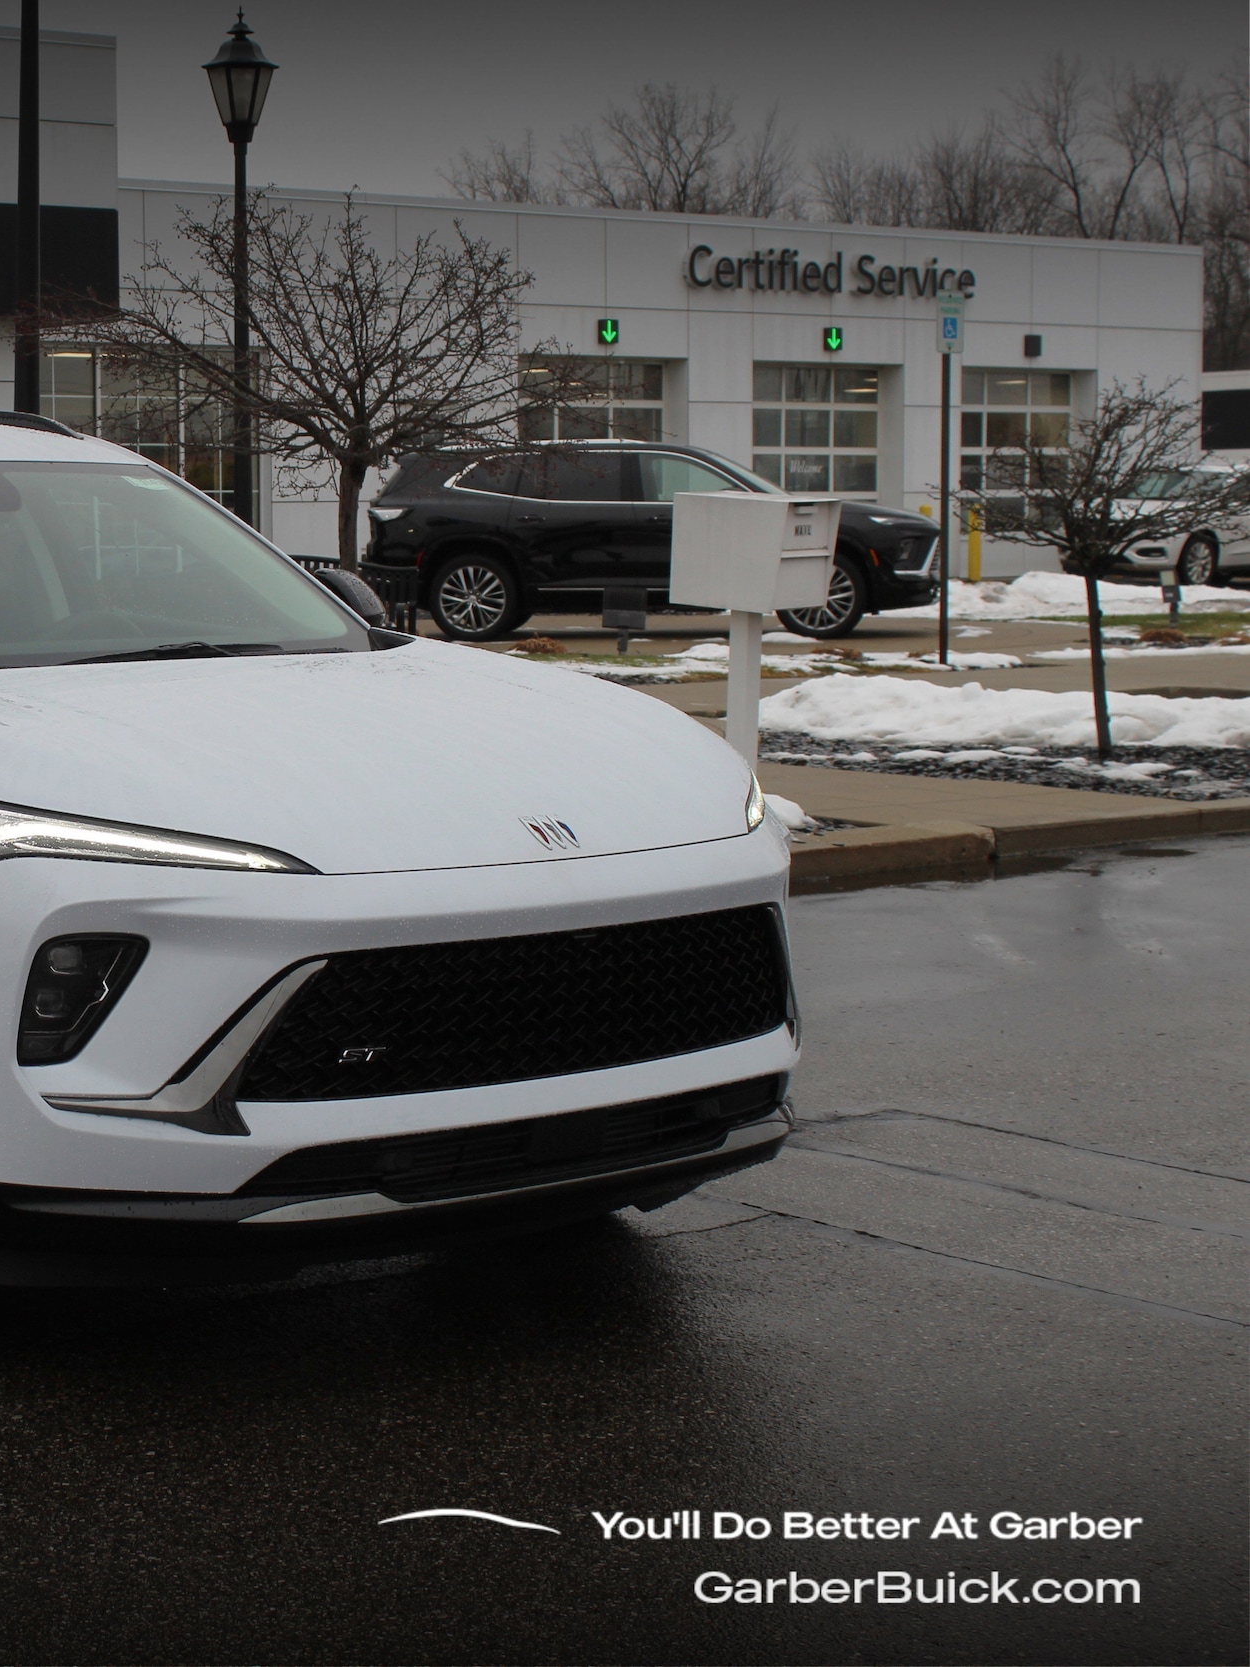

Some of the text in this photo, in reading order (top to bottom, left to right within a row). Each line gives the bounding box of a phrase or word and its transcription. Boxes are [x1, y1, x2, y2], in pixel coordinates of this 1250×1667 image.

[689, 244, 976, 299] Certified Service
[794, 525, 812, 536] MAIL
[338, 1046, 387, 1063] ST
